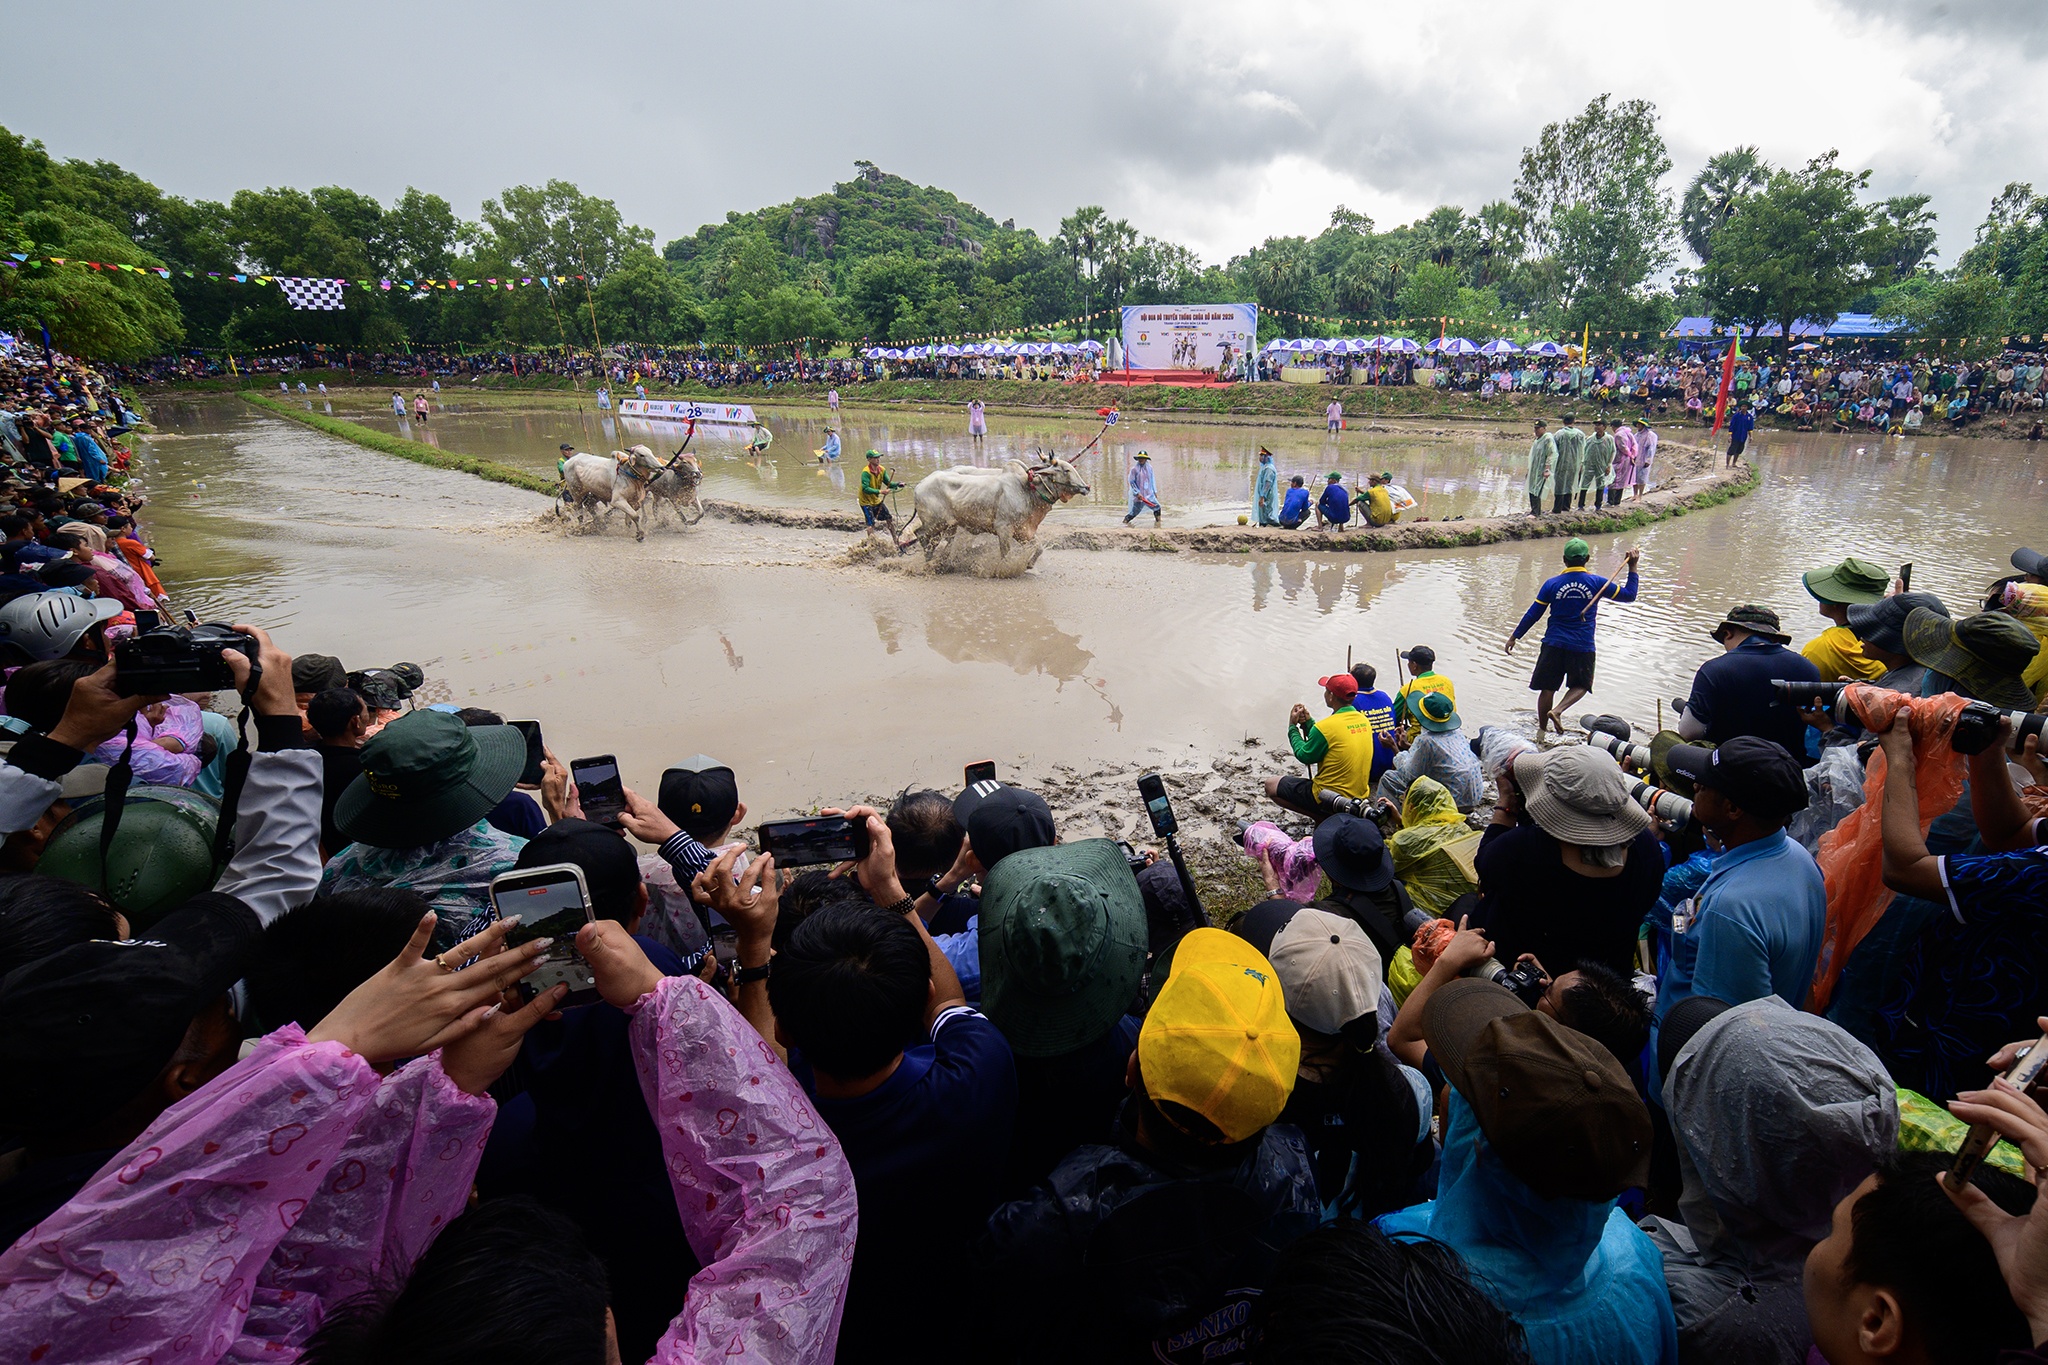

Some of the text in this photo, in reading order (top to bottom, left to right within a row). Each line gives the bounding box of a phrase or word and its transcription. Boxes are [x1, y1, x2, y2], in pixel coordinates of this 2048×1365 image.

[687, 407, 703, 419] 28
[1107, 412, 1118, 424] 08
[1676, 768, 1696, 780] adidas
[1167, 1299, 1252, 1353] SANKO
